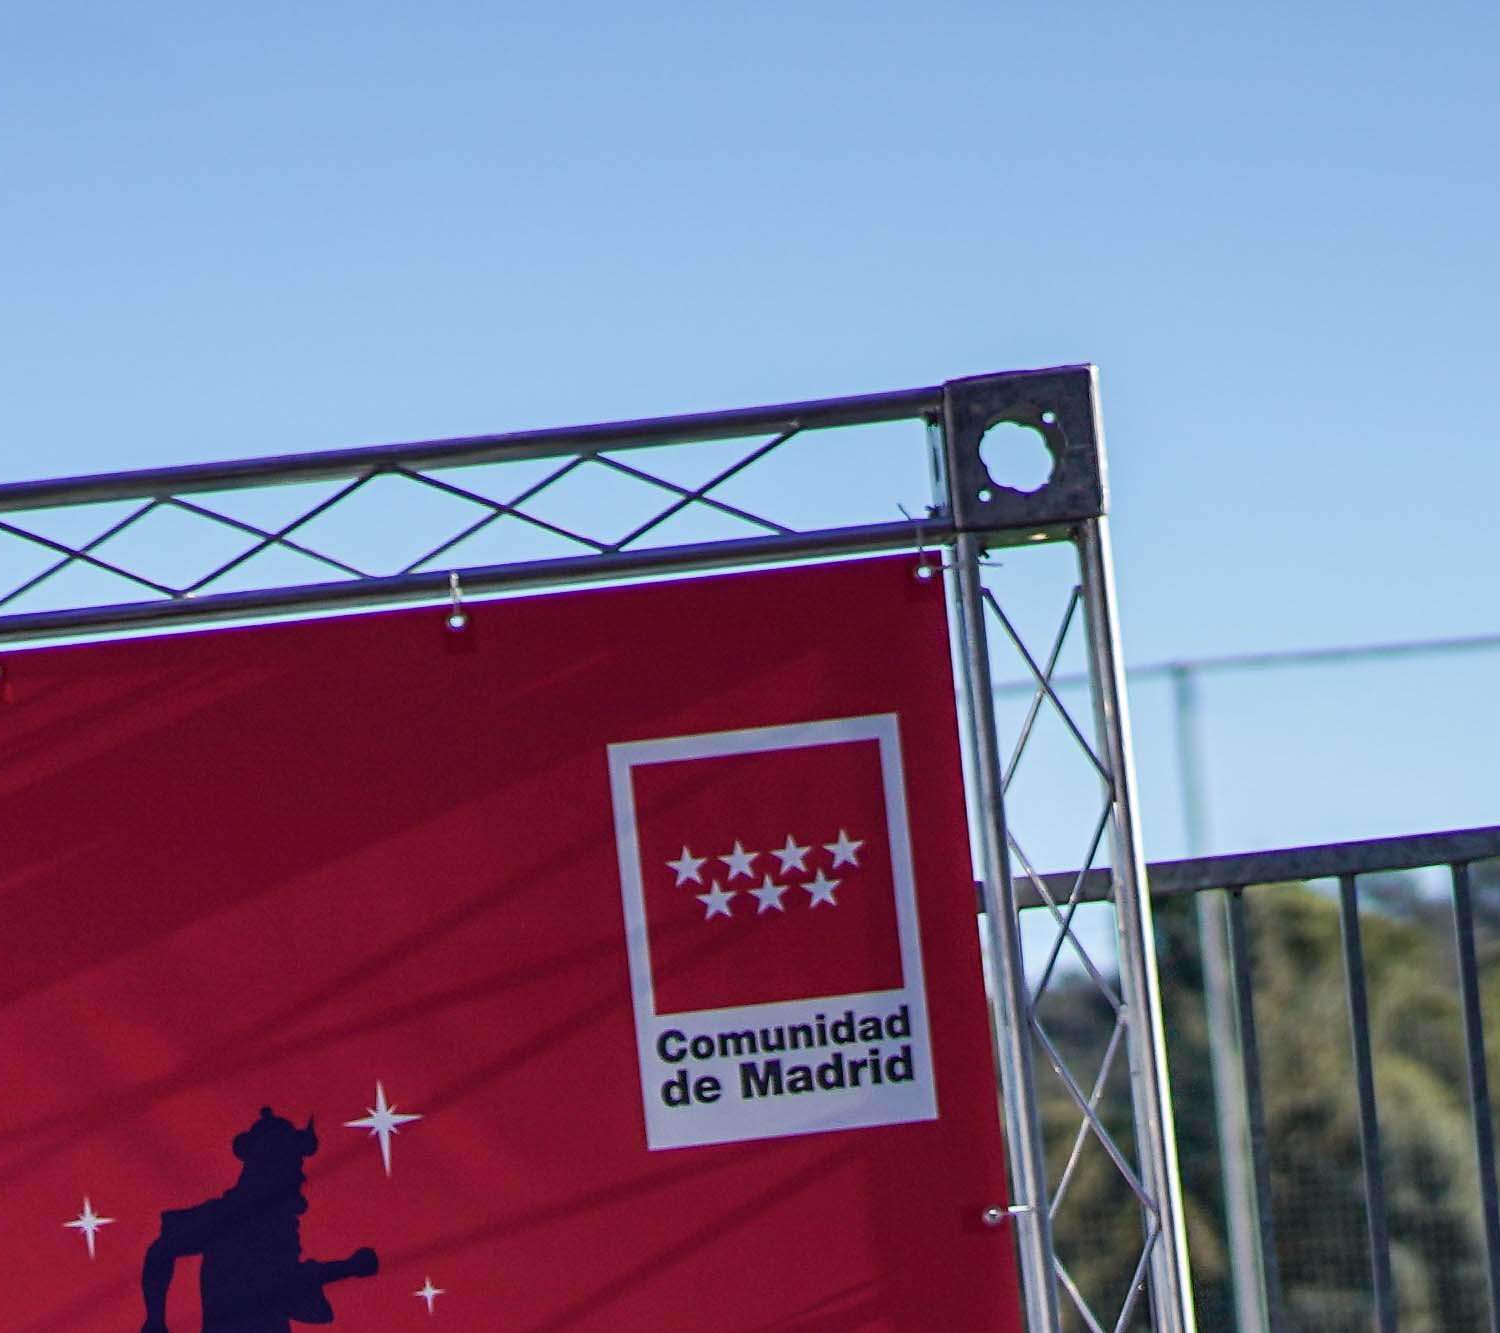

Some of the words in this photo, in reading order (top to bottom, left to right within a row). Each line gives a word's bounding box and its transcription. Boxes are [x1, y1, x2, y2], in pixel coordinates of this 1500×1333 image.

[656, 1005, 911, 1063] Comunidad
[661, 1070, 722, 1108] de
[740, 1046, 915, 1099] Madrid
